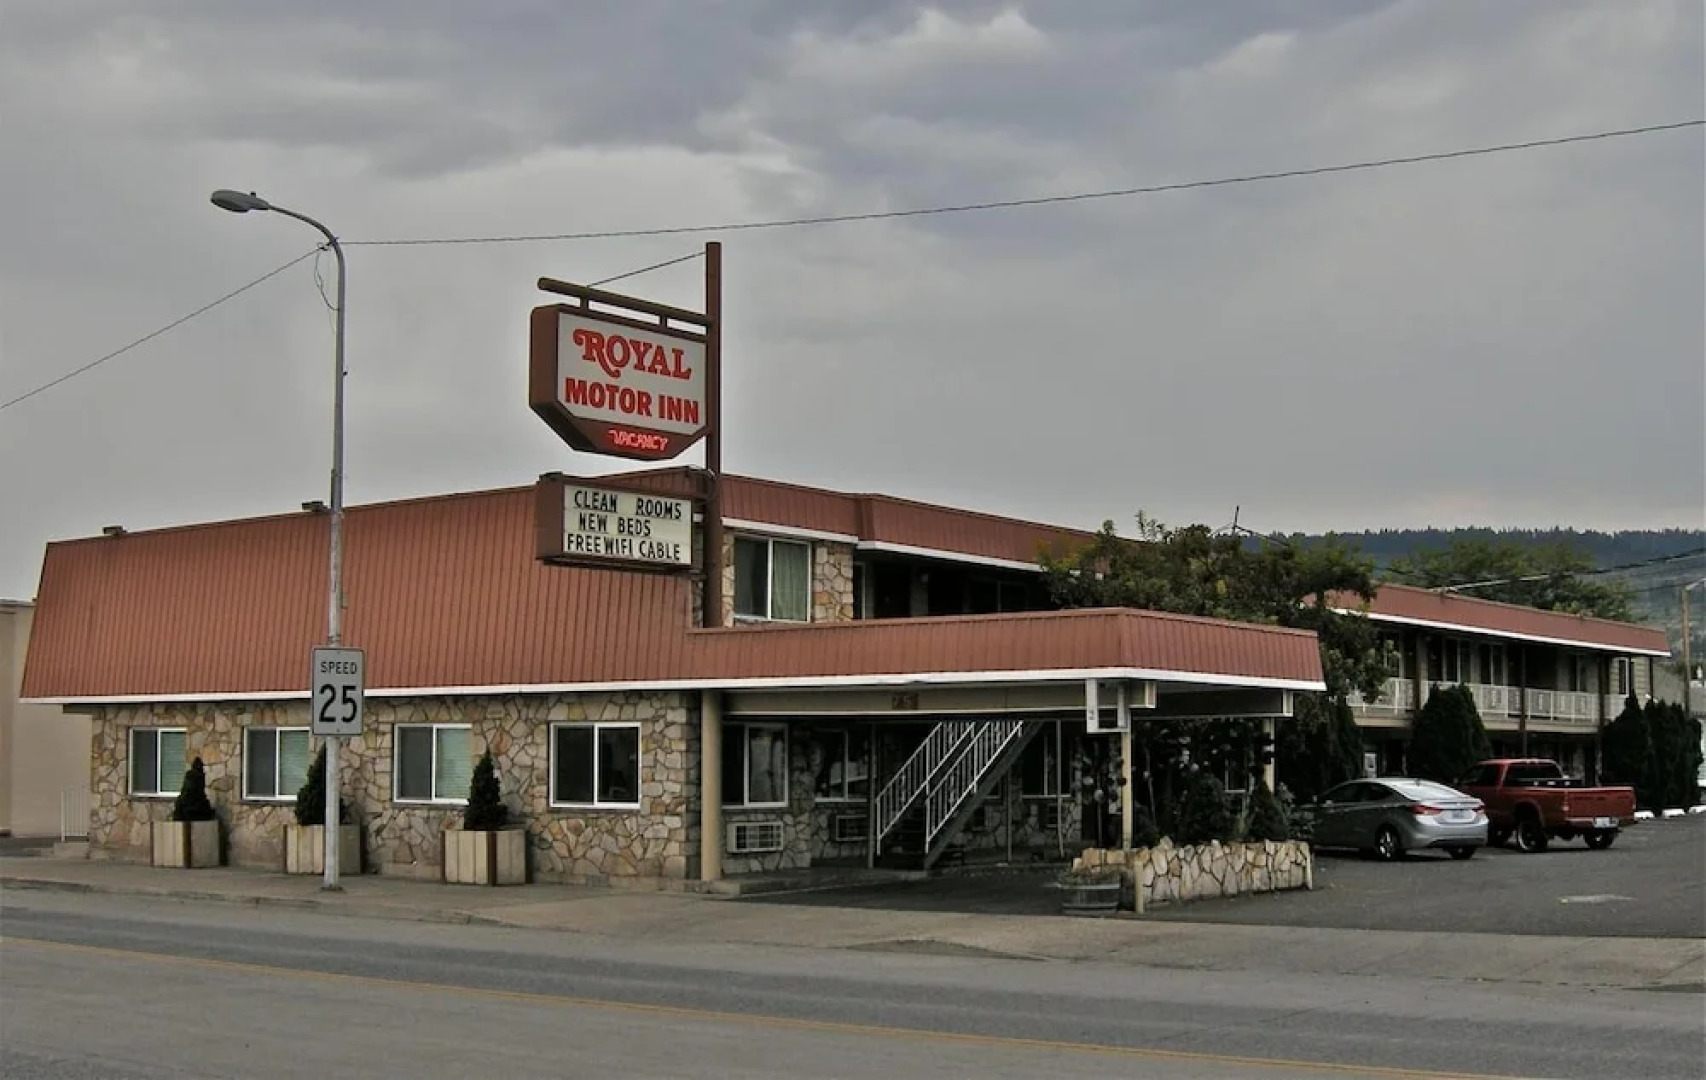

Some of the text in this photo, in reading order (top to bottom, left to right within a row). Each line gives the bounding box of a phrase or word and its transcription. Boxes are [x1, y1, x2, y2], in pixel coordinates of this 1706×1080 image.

[573, 328, 692, 380] ROYAL
[565, 377, 699, 424] MOTOR INN
[608, 430, 669, 451] VACANCY
[574, 490, 682, 520] CLEAN ROOMS
[579, 511, 651, 537] NEW BEDS
[567, 533, 680, 561] FREE WIFI CABLE
[320, 661, 358, 675] SPEED
[319, 683, 358, 723] 25
